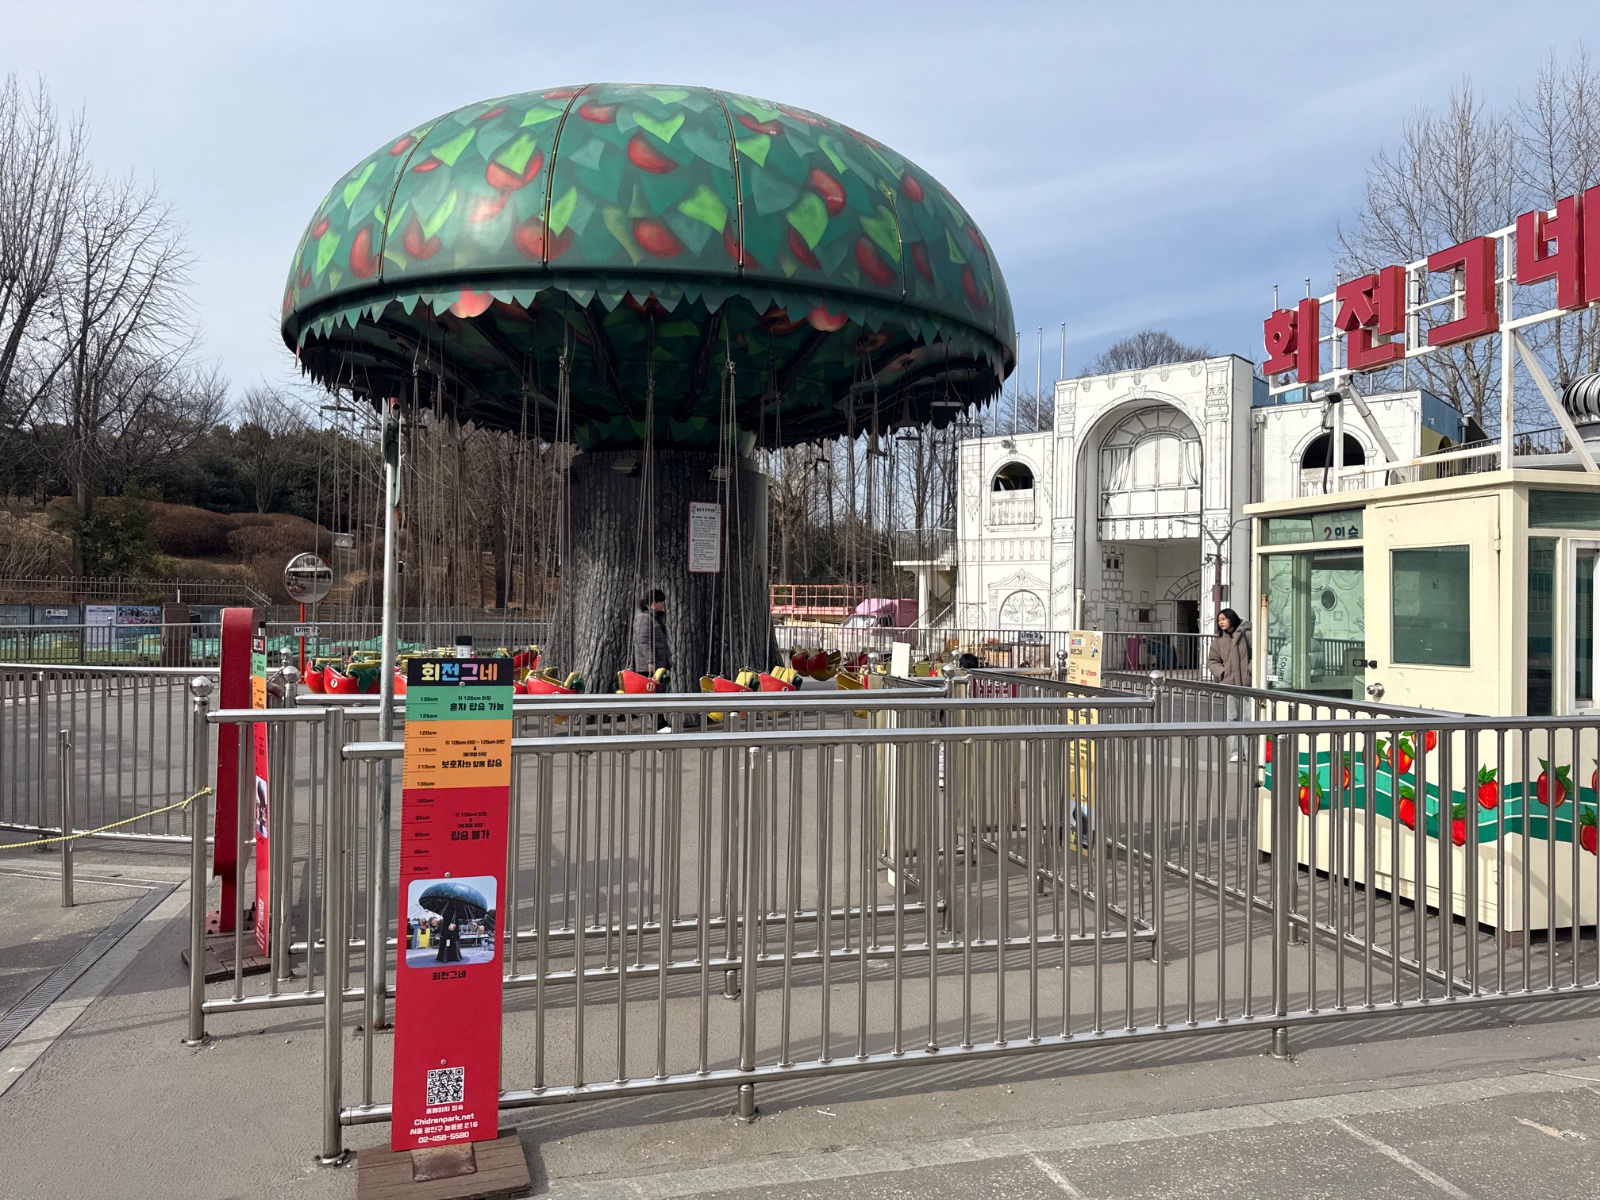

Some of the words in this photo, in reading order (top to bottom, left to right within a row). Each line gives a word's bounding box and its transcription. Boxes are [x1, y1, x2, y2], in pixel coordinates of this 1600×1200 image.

[1263, 184, 1600, 383] 회전그네
[421, 663, 498, 682] 회전그네
[450, 703, 467, 711] 혼자
[469, 703, 486, 711] 탑승
[489, 702, 504, 711] 가능
[442, 760, 472, 768] 보호자와
[487, 759, 502, 768] 탑승
[451, 831, 468, 841] 탑승
[472, 830, 490, 840] 불가
[432, 970, 466, 980] 회전그네
[414, 1113, 475, 1126] Chidrenpark.net
[424, 1126, 443, 1134] 광진구
